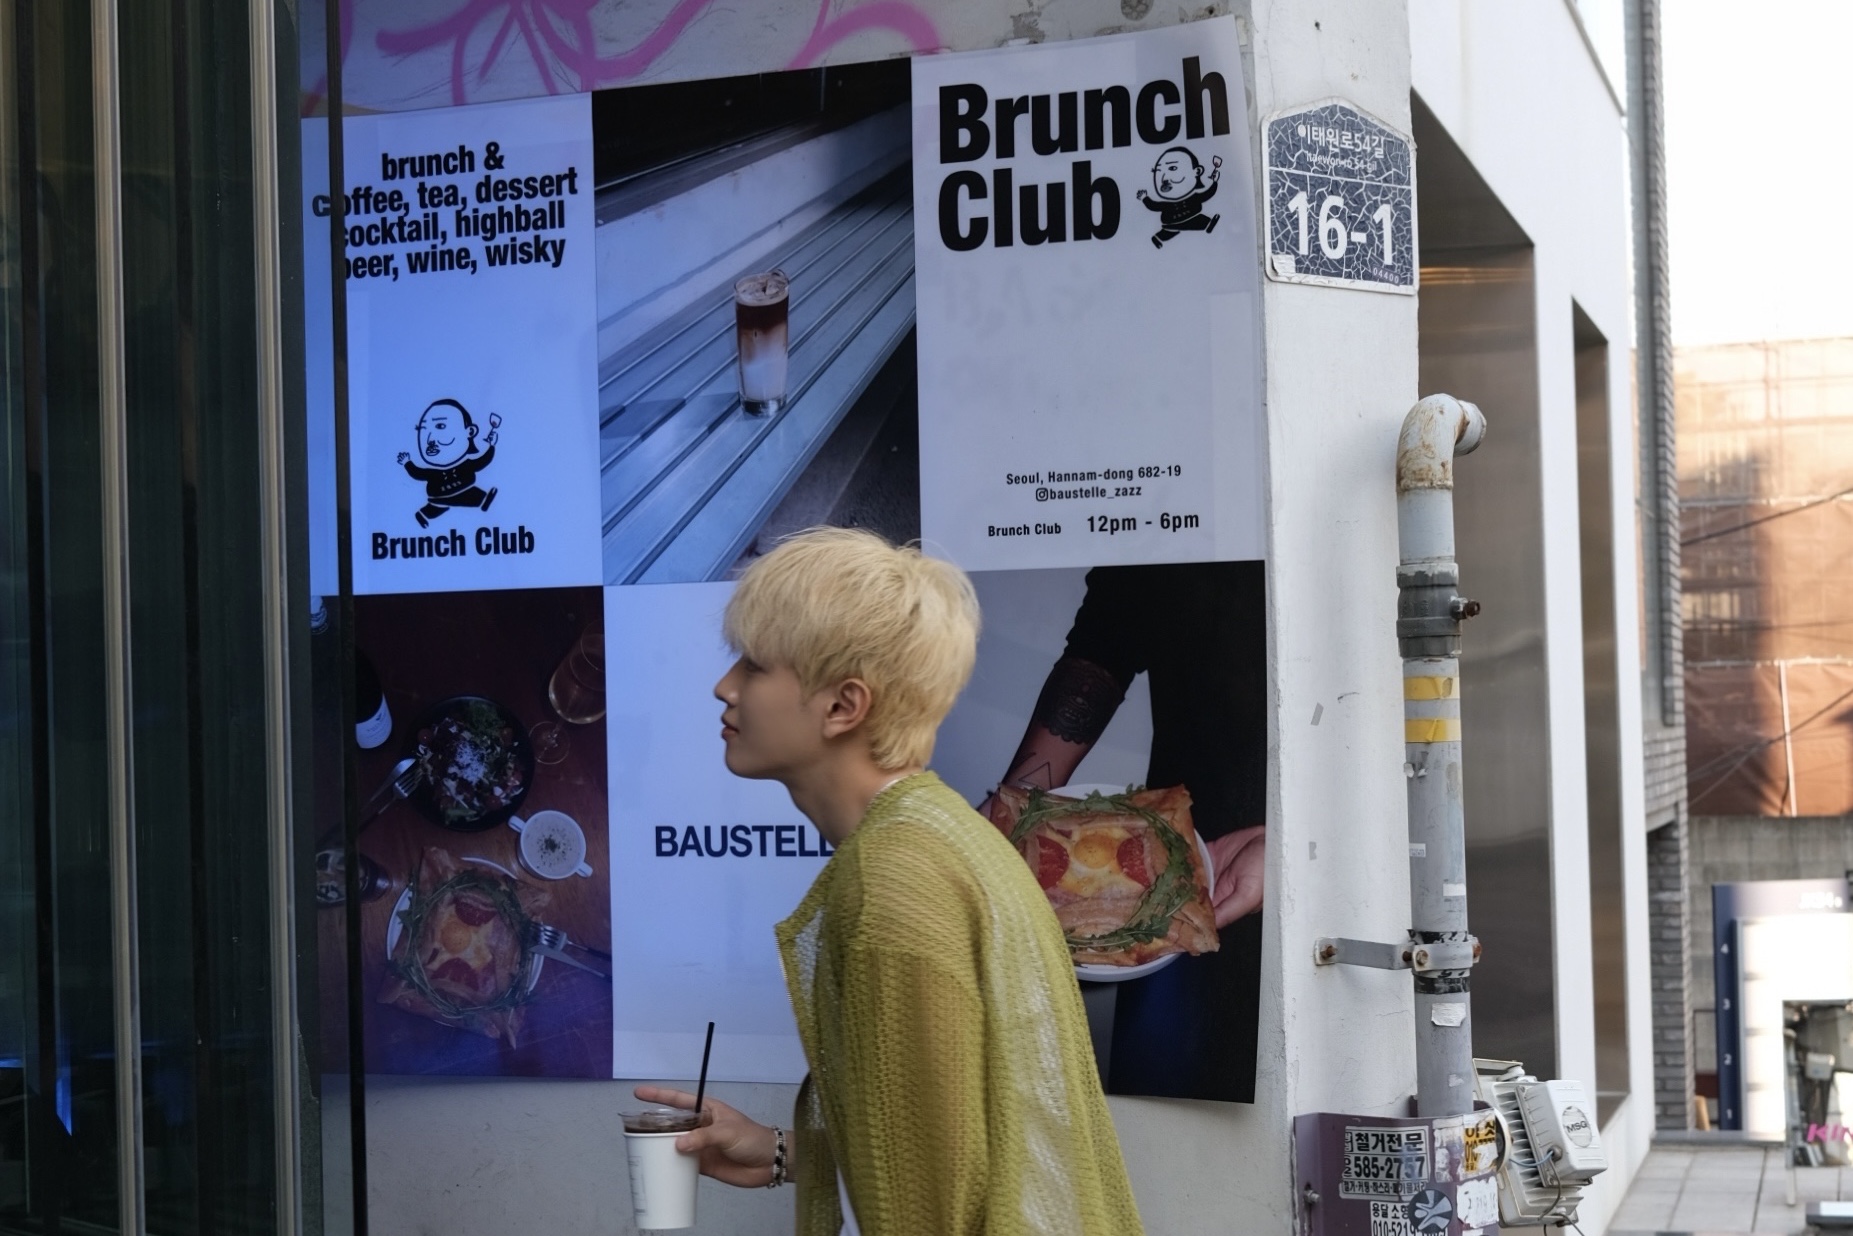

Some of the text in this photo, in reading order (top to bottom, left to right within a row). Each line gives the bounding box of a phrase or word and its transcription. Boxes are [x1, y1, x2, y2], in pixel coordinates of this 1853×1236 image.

[939, 55, 1231, 164] Brunch
[382, 141, 506, 181] brunch &
[1297, 124, 1385, 159] 이태원로54길
[417, 182, 468, 212] tea,
[475, 167, 579, 203] dessert
[938, 160, 1121, 252] Club
[455, 199, 566, 242] highball
[1287, 190, 1394, 266] 16-1
[406, 244, 478, 275] wine,
[485, 234, 566, 268] wisky
[1372, 267, 1400, 285] 04400
[1006, 464, 1182, 486] Seoul, Hannam-dong 682-19
[372, 525, 535, 560] Brunch Club
[988, 524, 1030, 537] Brunch
[1034, 522, 1062, 535] Club
[1087, 515, 1137, 535] 12pm
[1160, 512, 1200, 533] 6pm
[1355, 1132, 1424, 1153] 철거전문
